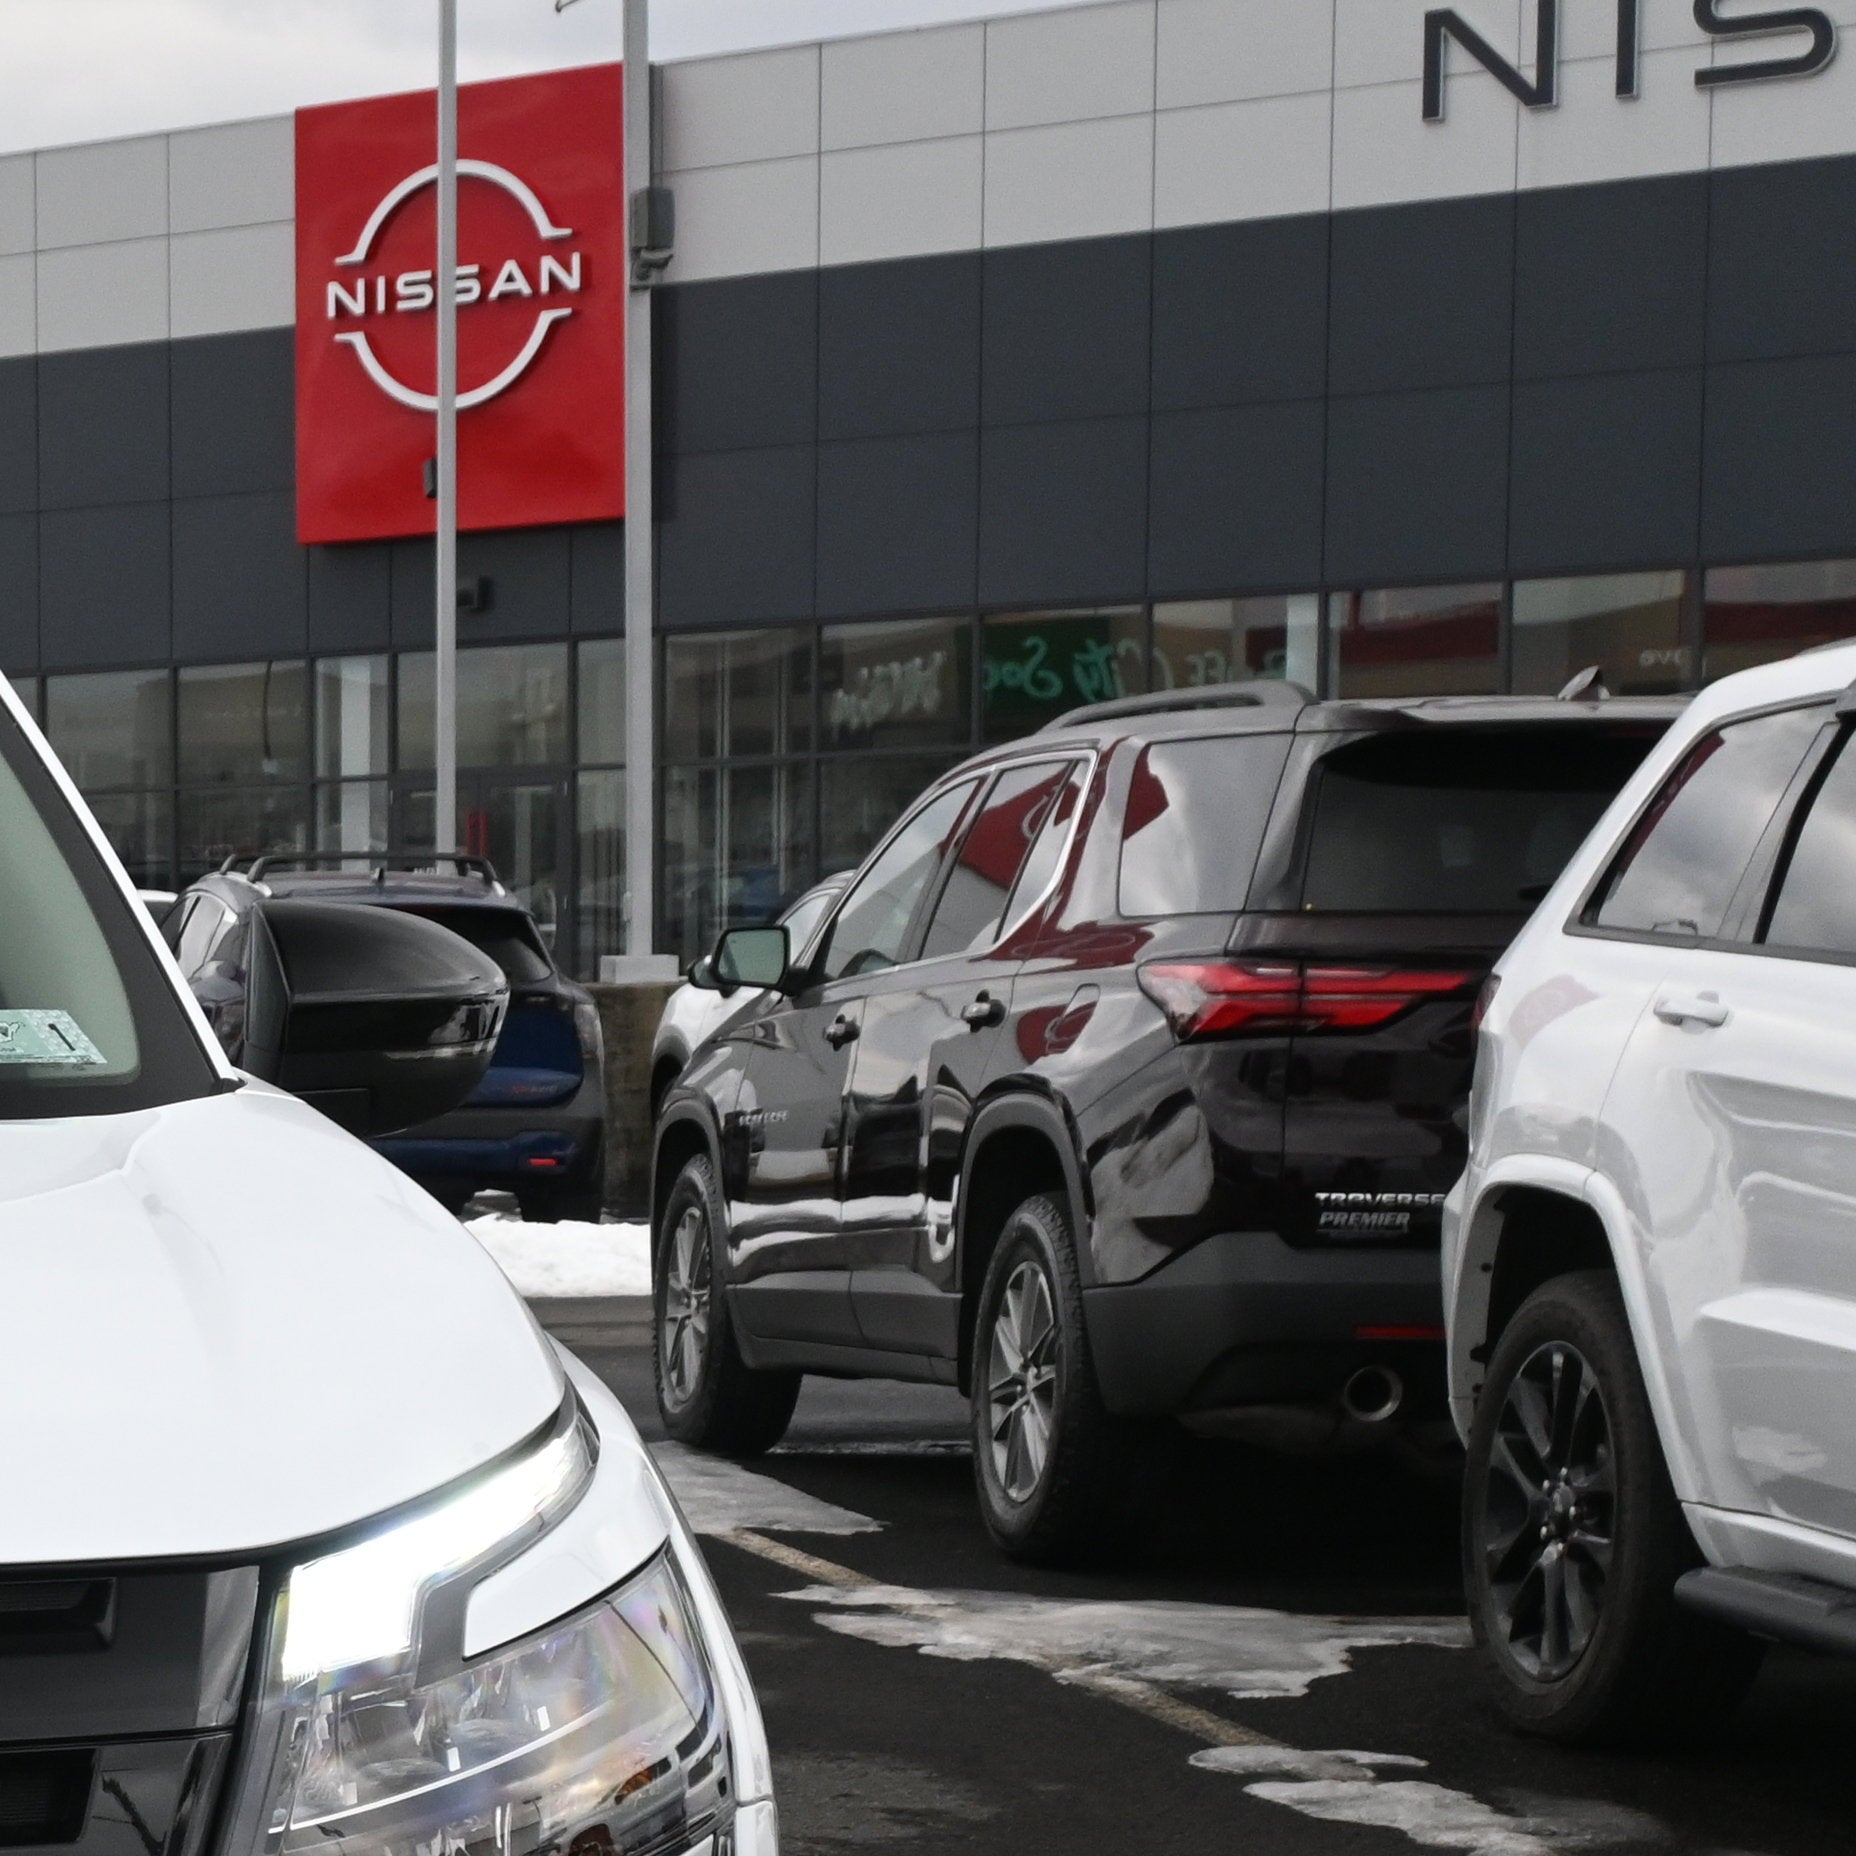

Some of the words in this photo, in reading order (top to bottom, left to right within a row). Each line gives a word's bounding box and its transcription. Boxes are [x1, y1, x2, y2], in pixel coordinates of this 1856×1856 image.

[326, 251, 582, 320] NISSAN
[47, 1022, 76, 1052] 1
[1315, 1192, 1446, 1207] TRAVERSE
[1319, 1211, 1411, 1227] PREMIER
